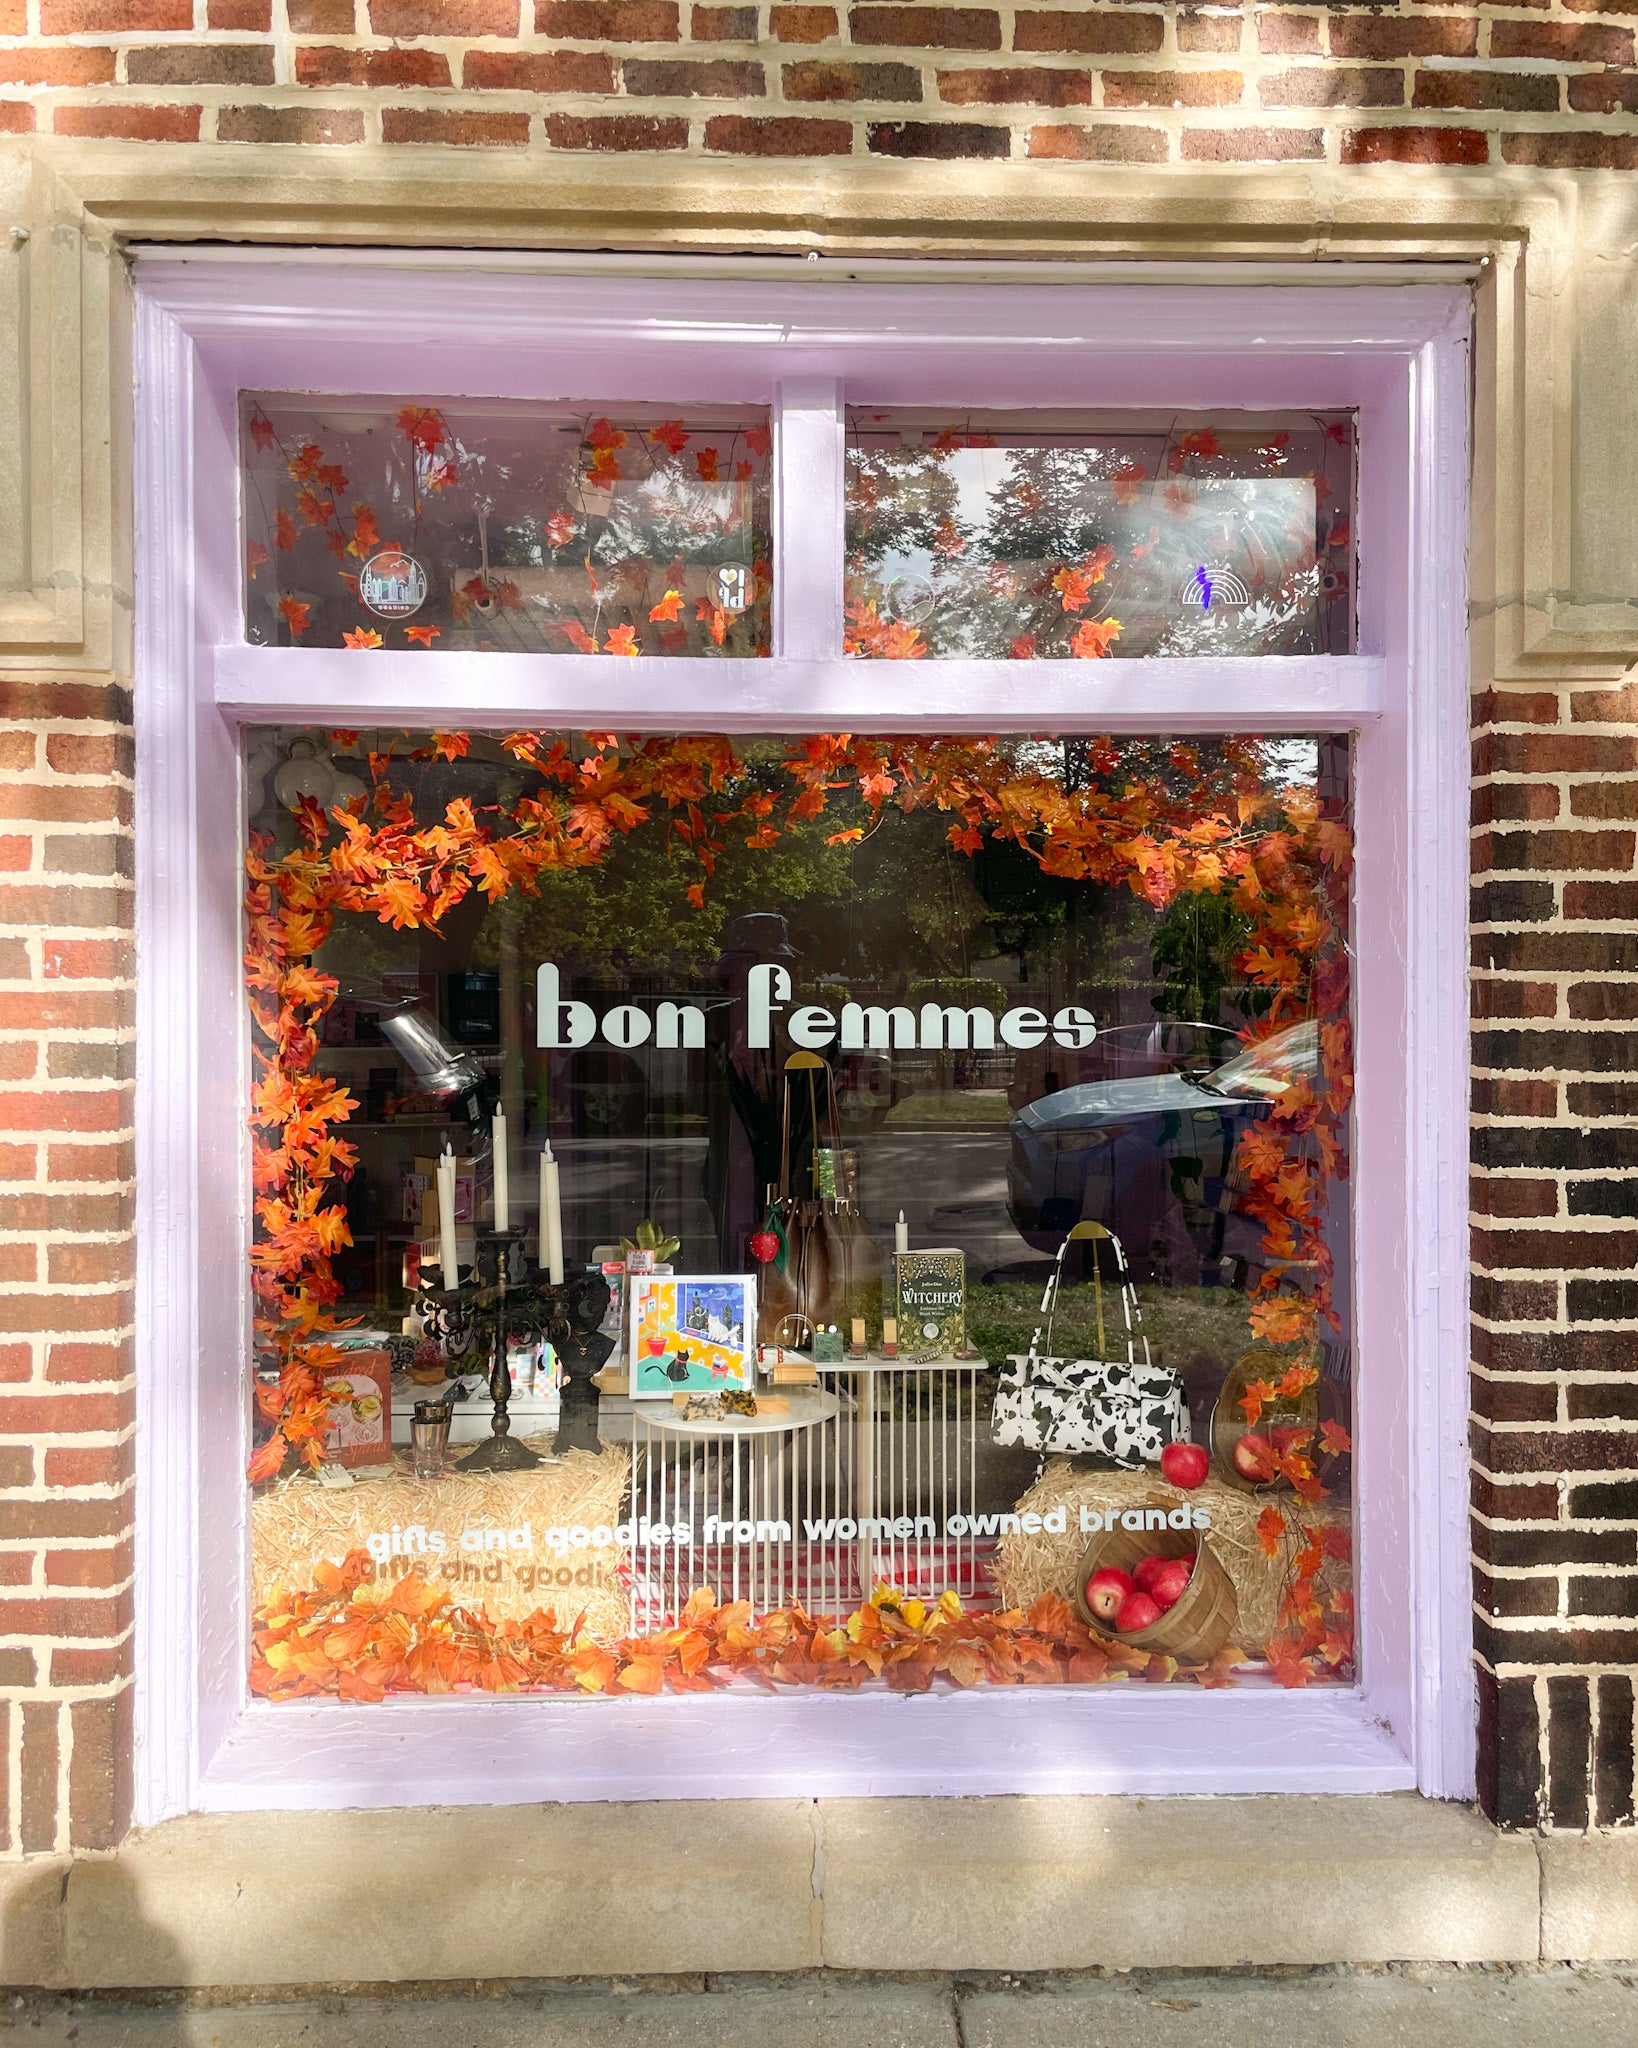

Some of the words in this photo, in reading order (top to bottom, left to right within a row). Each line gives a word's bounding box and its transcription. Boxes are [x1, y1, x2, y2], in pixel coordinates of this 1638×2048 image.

[537, 962, 706, 1049] bon
[748, 963, 1097, 1050] femmes
[902, 1288, 962, 1307] WITCHERY
[366, 1523, 448, 1564] gifts
[459, 1521, 532, 1552] and
[545, 1515, 691, 1557] goodies
[703, 1514, 792, 1545] from
[802, 1513, 936, 1540] women
[946, 1505, 1067, 1537] owned
[1080, 1502, 1211, 1532] brands
